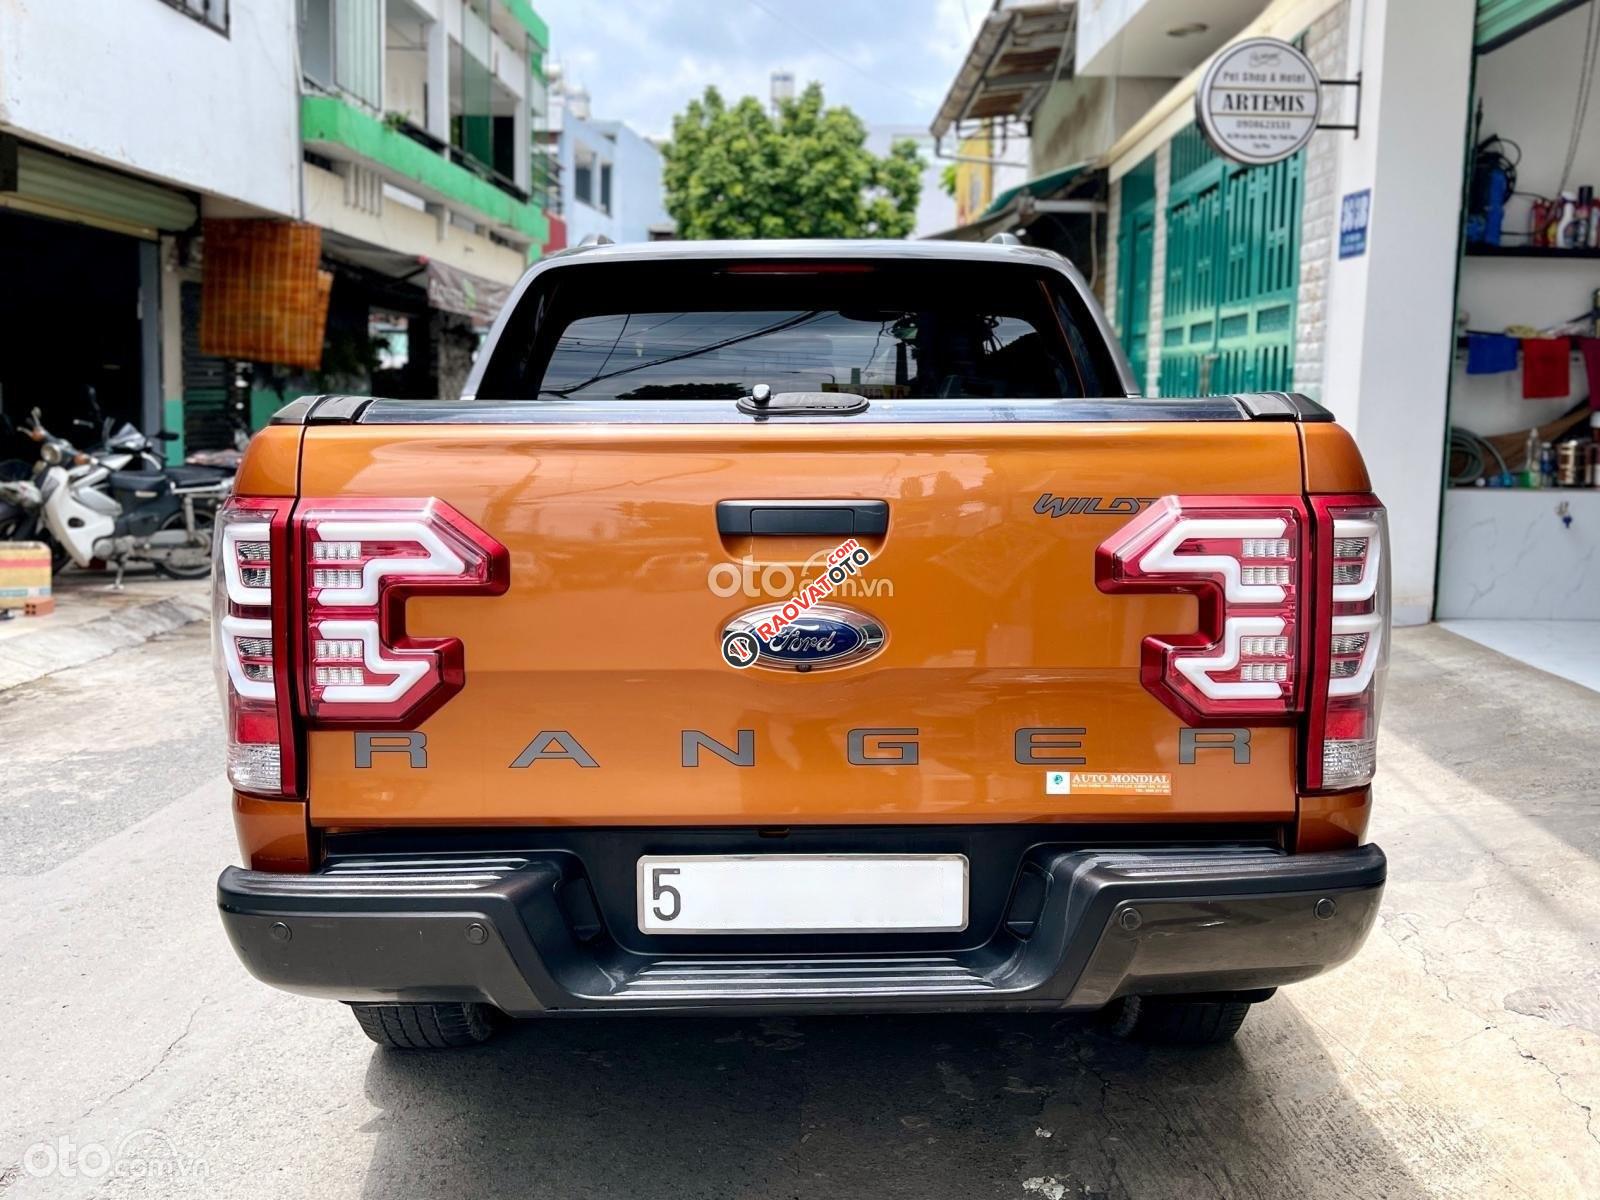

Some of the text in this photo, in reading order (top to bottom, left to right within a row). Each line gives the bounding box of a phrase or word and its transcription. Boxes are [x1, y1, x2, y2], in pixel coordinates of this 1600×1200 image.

[1222, 93, 1305, 112] ARTEMIS
[769, 623, 837, 652] Ford
[353, 727, 1252, 769] RANGER
[1072, 774, 1169, 784] AUTO MONDIAL
[652, 867, 682, 922] 5
